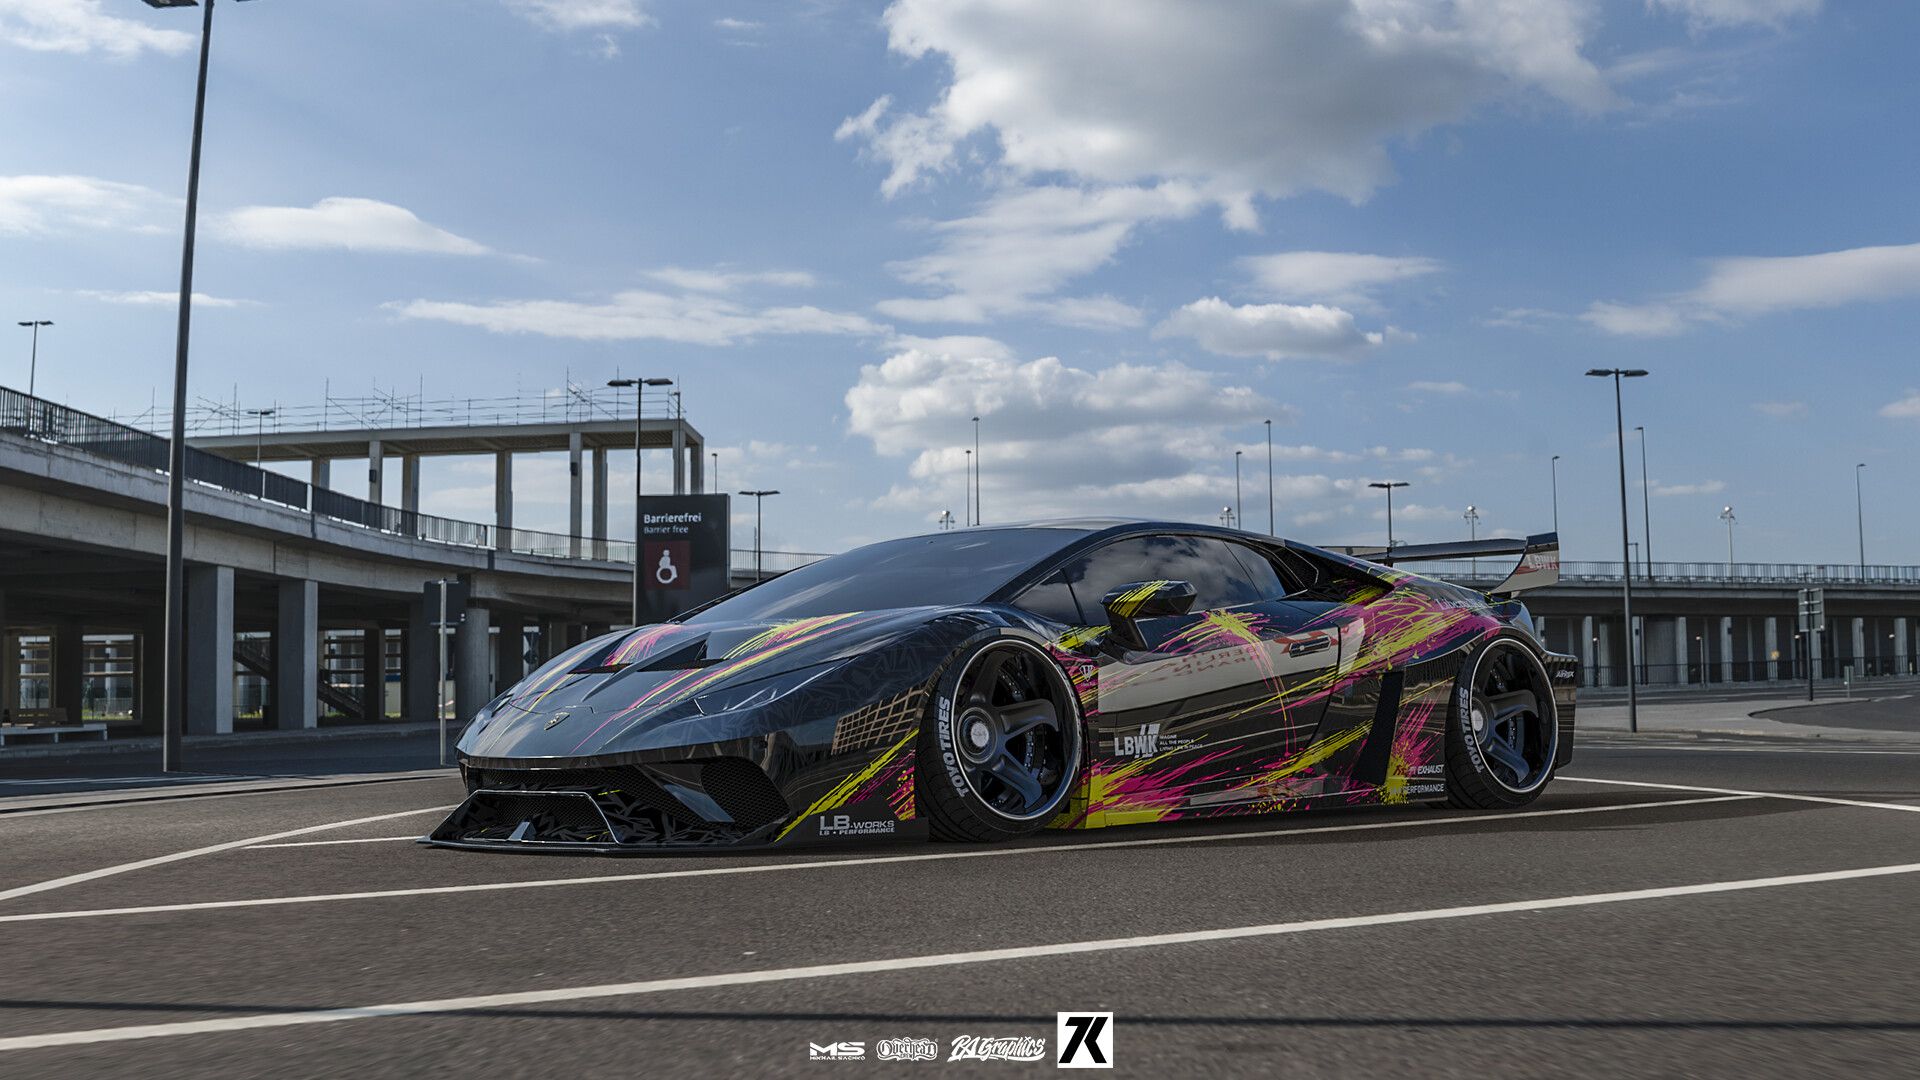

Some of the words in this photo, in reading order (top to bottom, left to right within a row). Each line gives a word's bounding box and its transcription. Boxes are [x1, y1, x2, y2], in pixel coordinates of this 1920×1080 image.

[644, 512, 702, 524] Barrierefrei
[644, 526, 670, 534] Barrier
[673, 525, 689, 533] free
[1460, 687, 1471, 734] TIRES
[938, 696, 951, 751] TIRES
[1114, 733, 1159, 757] LBWK
[1464, 734, 1485, 773] TOYO
[943, 752, 969, 798] TOYO
[1418, 764, 1445, 775] EXHAUST
[839, 827, 895, 835] PERFORMANCE
